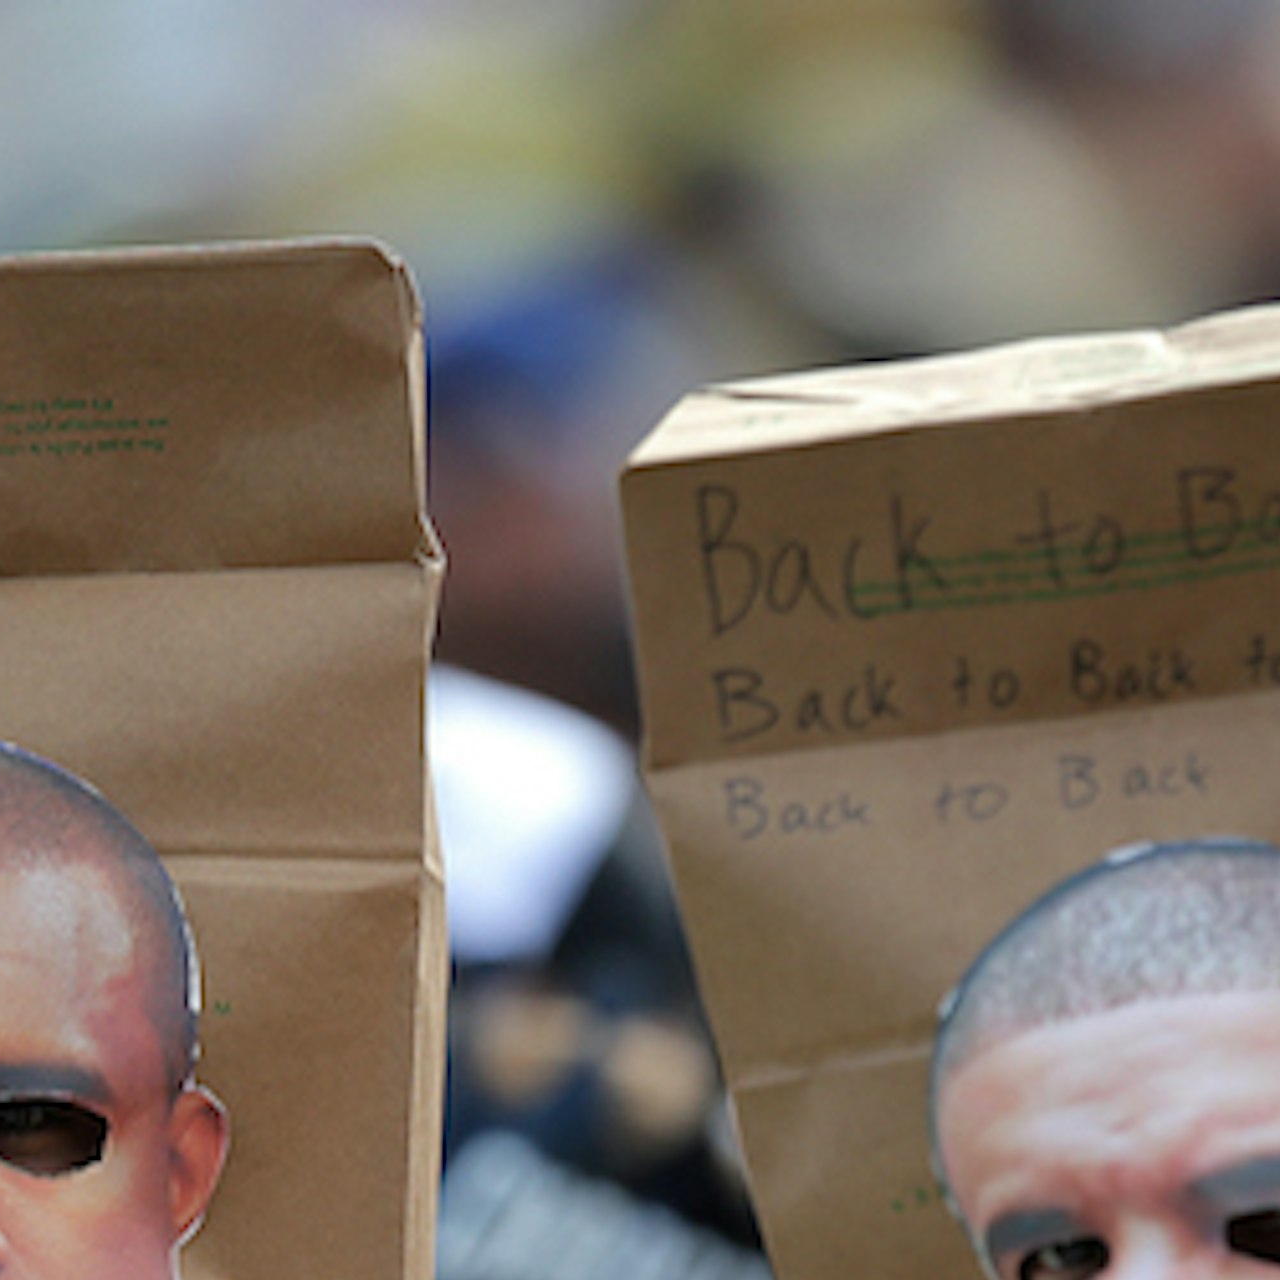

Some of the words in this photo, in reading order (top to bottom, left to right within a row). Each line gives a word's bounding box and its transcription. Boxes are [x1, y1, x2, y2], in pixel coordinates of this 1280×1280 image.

[696, 484, 952, 638] Back
[1014, 492, 1124, 586] to
[713, 667, 903, 743] Back
[952, 655, 1022, 710] to
[724, 776, 872, 841] Back
[934, 782, 1010, 822] to
[1058, 754, 1212, 811] Back
